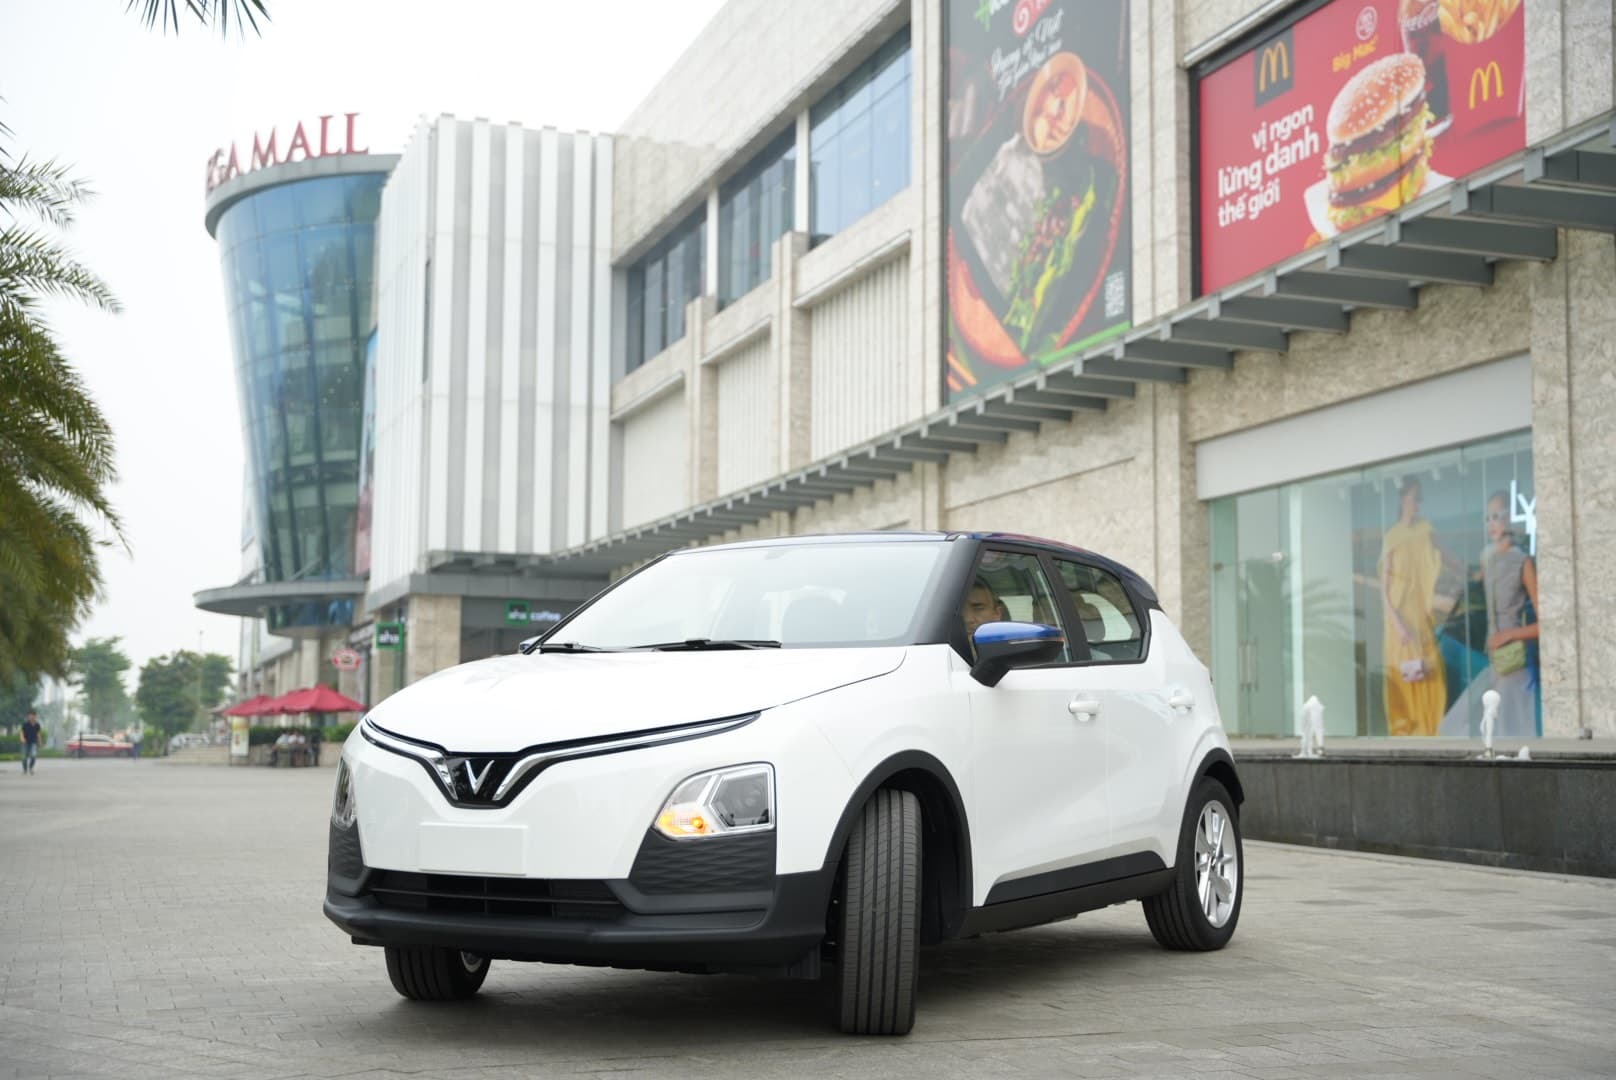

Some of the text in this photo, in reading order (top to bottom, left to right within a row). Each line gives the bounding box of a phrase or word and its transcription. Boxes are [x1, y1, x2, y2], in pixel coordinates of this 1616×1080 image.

[250, 112, 369, 171] MALL
[1252, 103, 1314, 152] vị ngon
[1265, 124, 1319, 175] danh
[1218, 192, 1248, 227] thế
